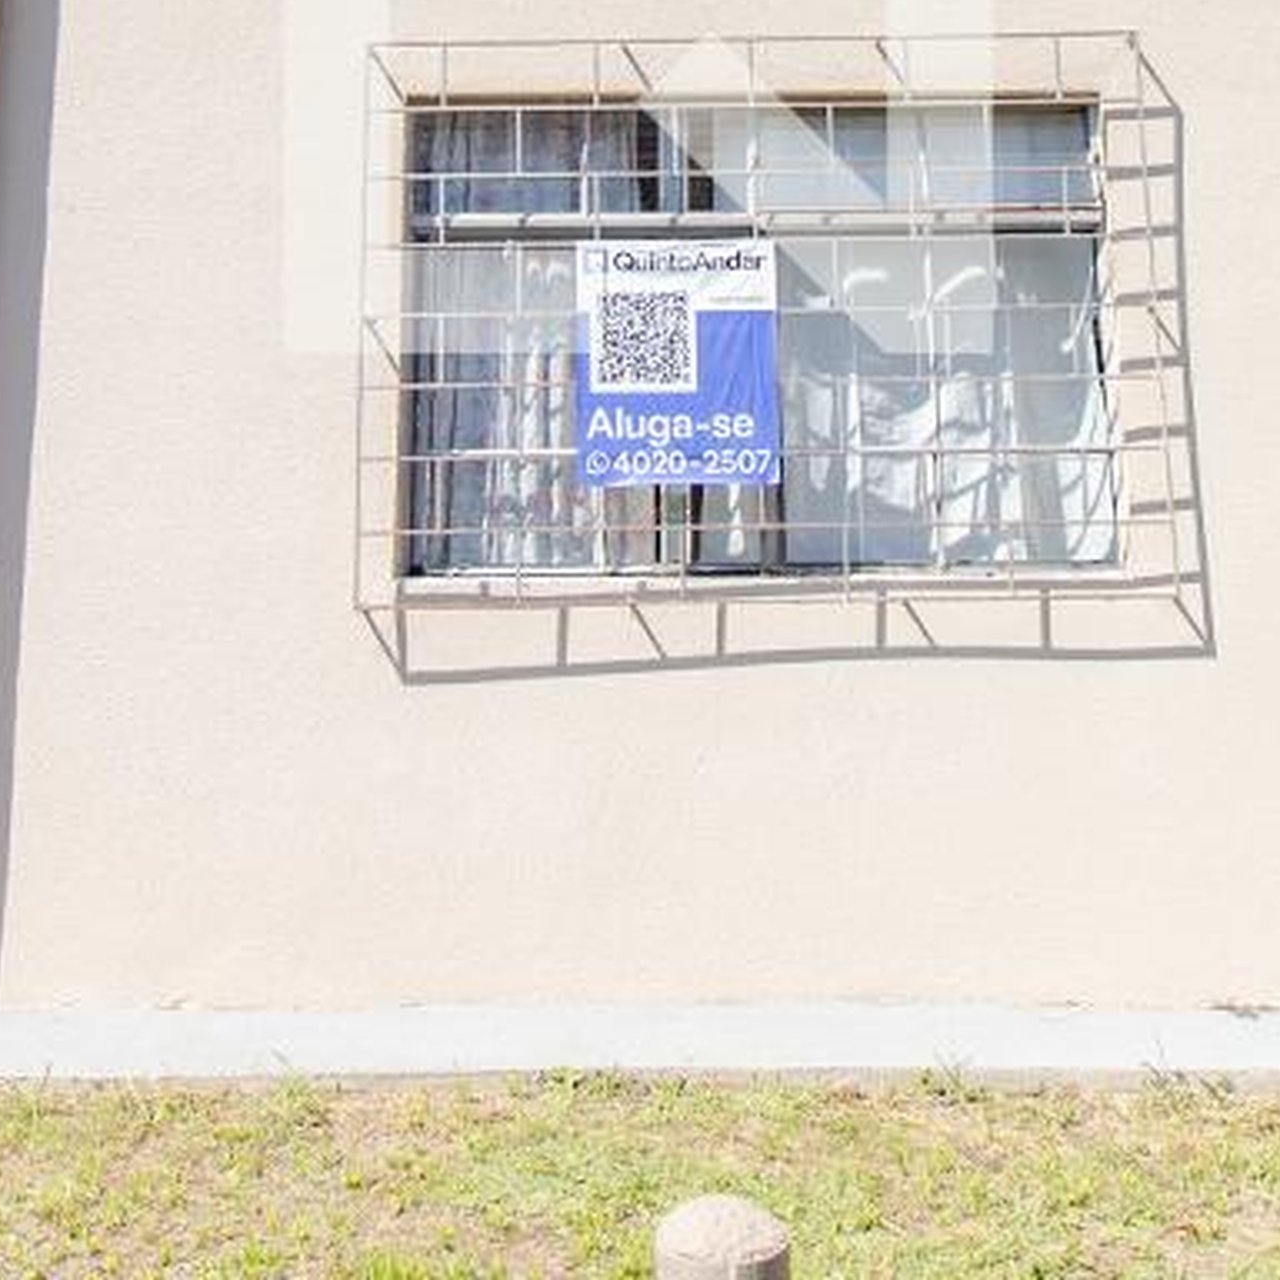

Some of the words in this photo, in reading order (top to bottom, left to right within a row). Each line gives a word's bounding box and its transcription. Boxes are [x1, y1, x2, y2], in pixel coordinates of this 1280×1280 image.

[612, 251, 764, 271] QuintoAndar
[587, 407, 755, 447] Aluga-se
[613, 449, 771, 475] 4020-2507
